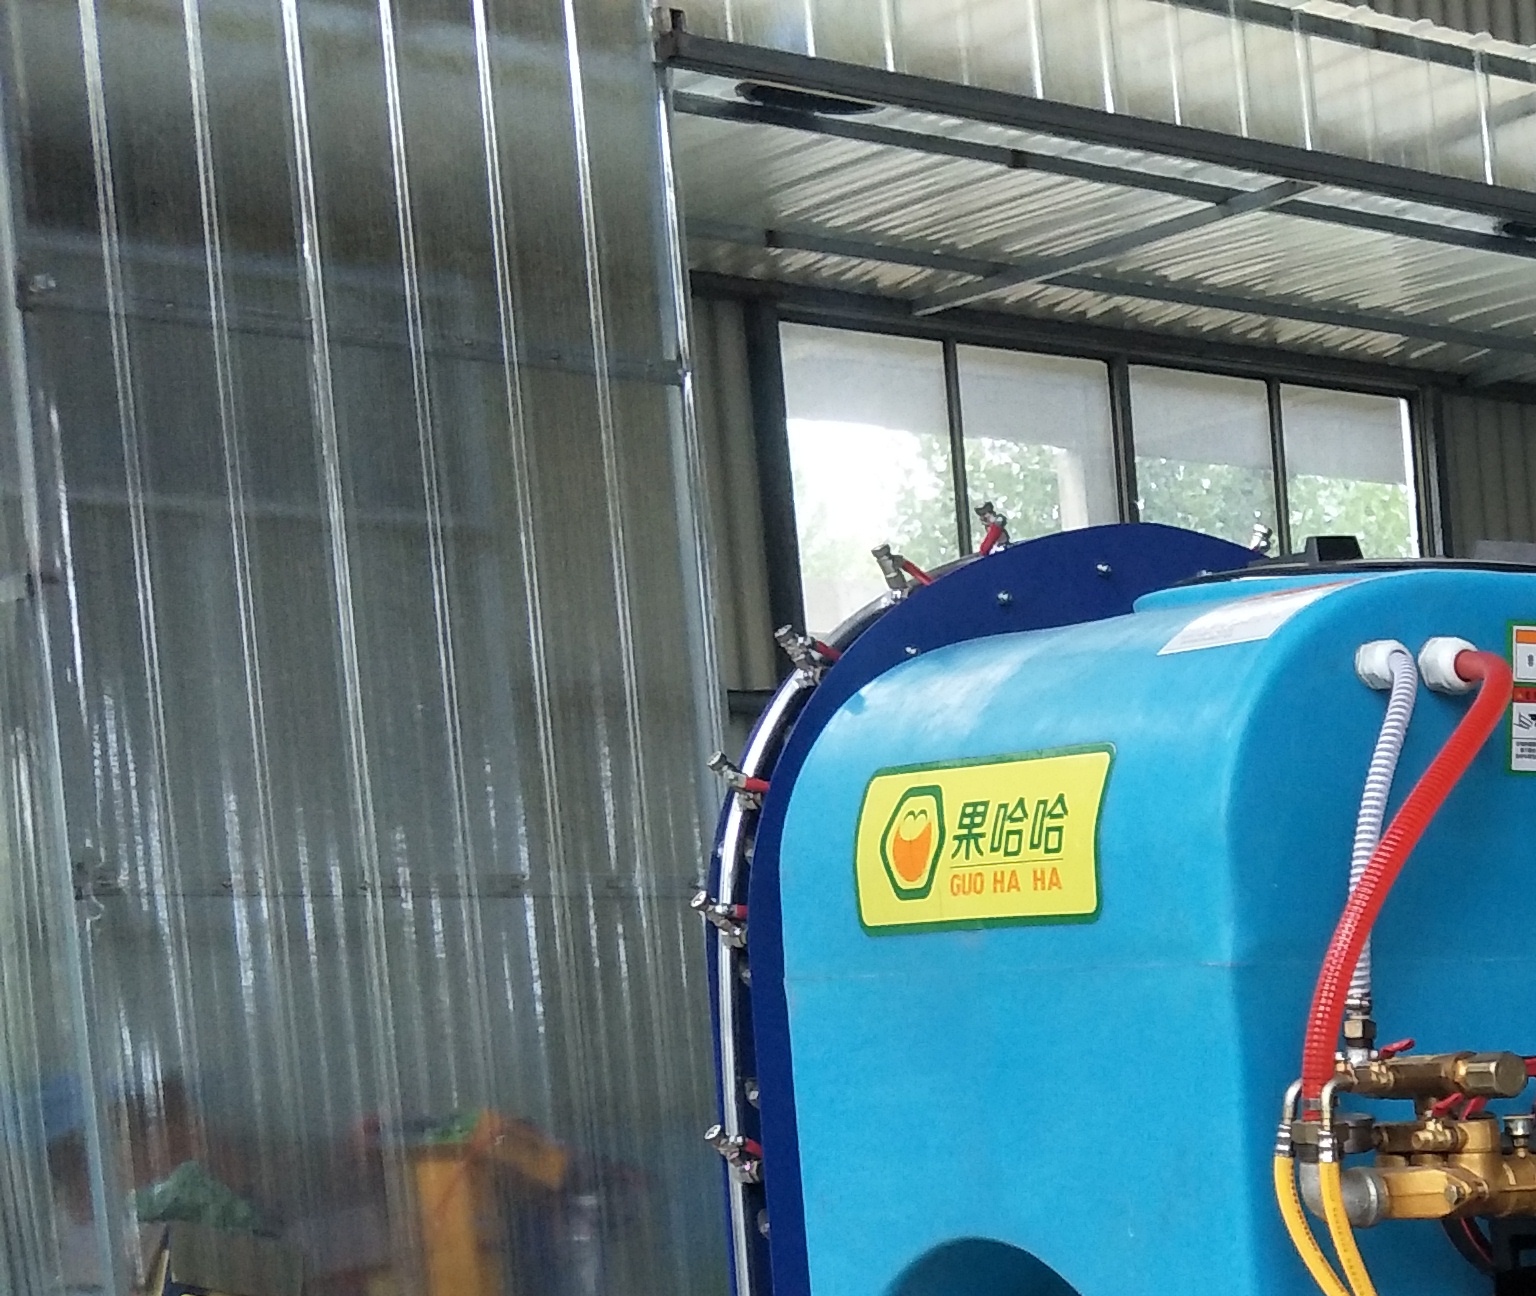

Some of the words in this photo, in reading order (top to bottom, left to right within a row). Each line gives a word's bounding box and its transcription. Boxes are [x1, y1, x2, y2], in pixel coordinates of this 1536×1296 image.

[951, 793, 1069, 861] 果哈哈
[950, 872, 985, 897] GUO
[992, 870, 1022, 894] HA
[1033, 867, 1063, 892] HA
